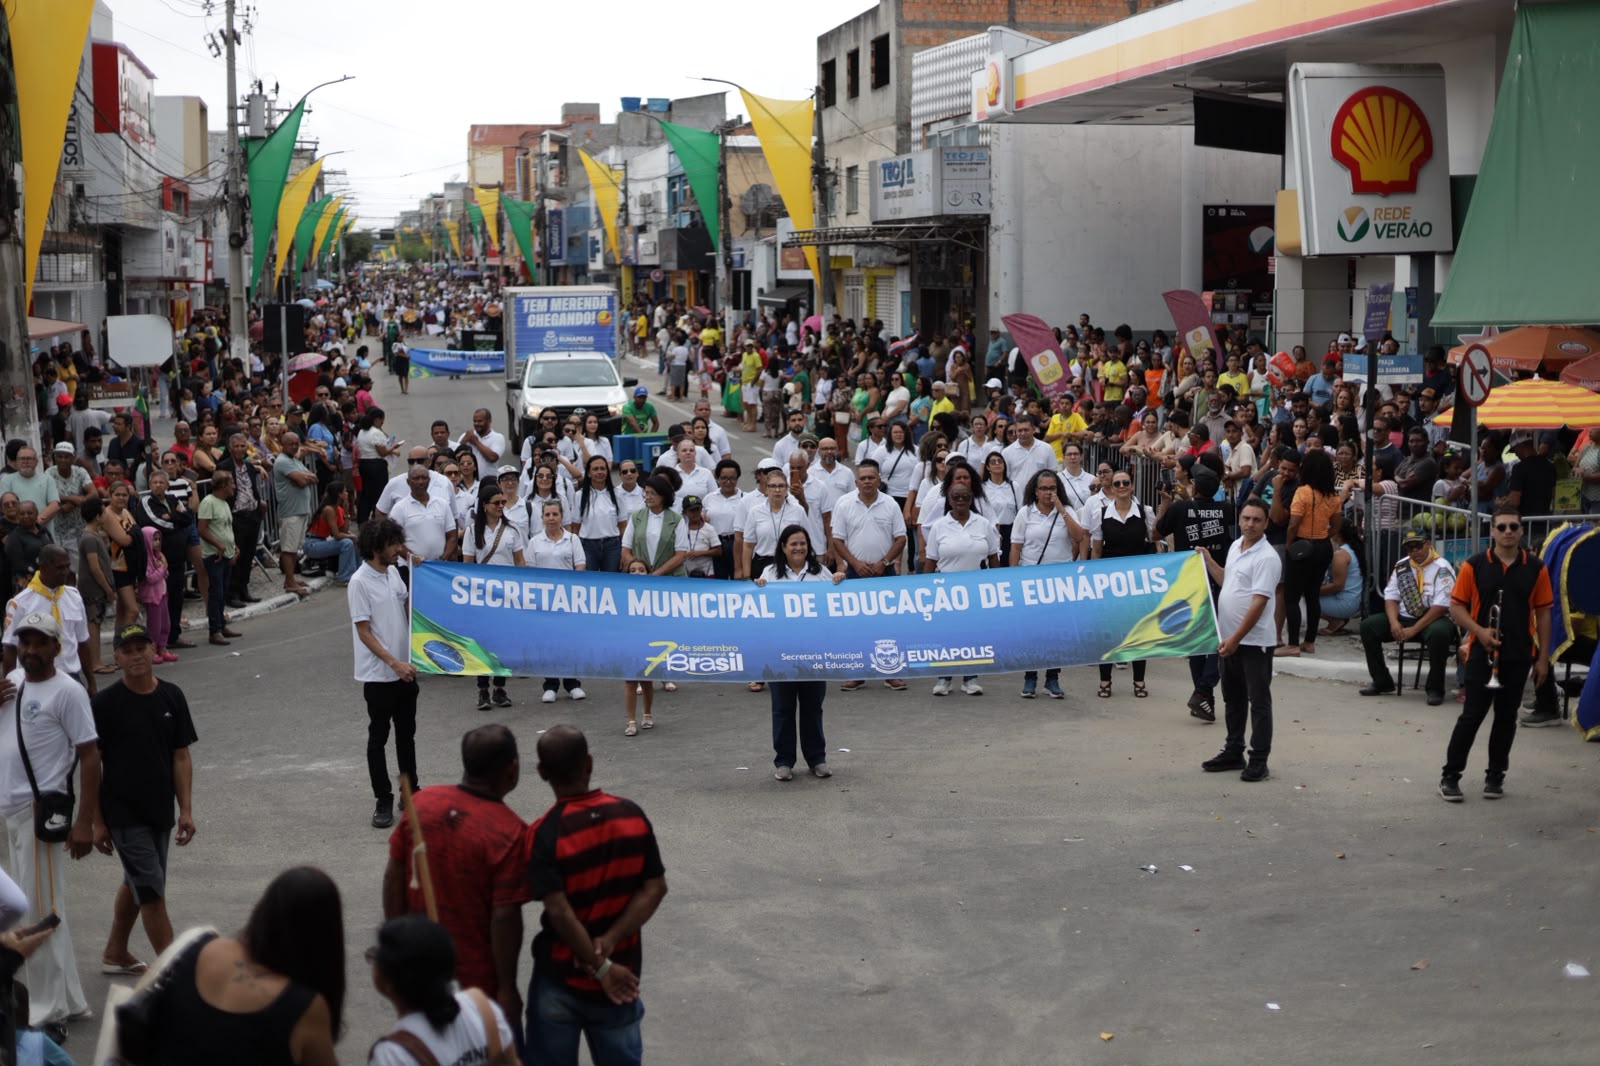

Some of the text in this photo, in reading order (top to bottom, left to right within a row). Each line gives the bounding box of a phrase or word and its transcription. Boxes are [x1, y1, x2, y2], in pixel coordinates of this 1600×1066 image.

[1373, 206, 1413, 221] REDE
[1373, 219, 1433, 239] VERÃO
[522, 296, 609, 313] TEM MERENDA
[527, 311, 597, 328] CHEGANDO!
[451, 566, 1170, 621] SECRETARIA MUNICIPAL DE EDUCAÇÃO DE EUNÁPOLIS
[644, 641, 739, 677] 7 de setembro
[666, 652, 744, 672] Brasil
[781, 652, 863, 662] Secretaria Municipal
[812, 661, 865, 671] de Educação
